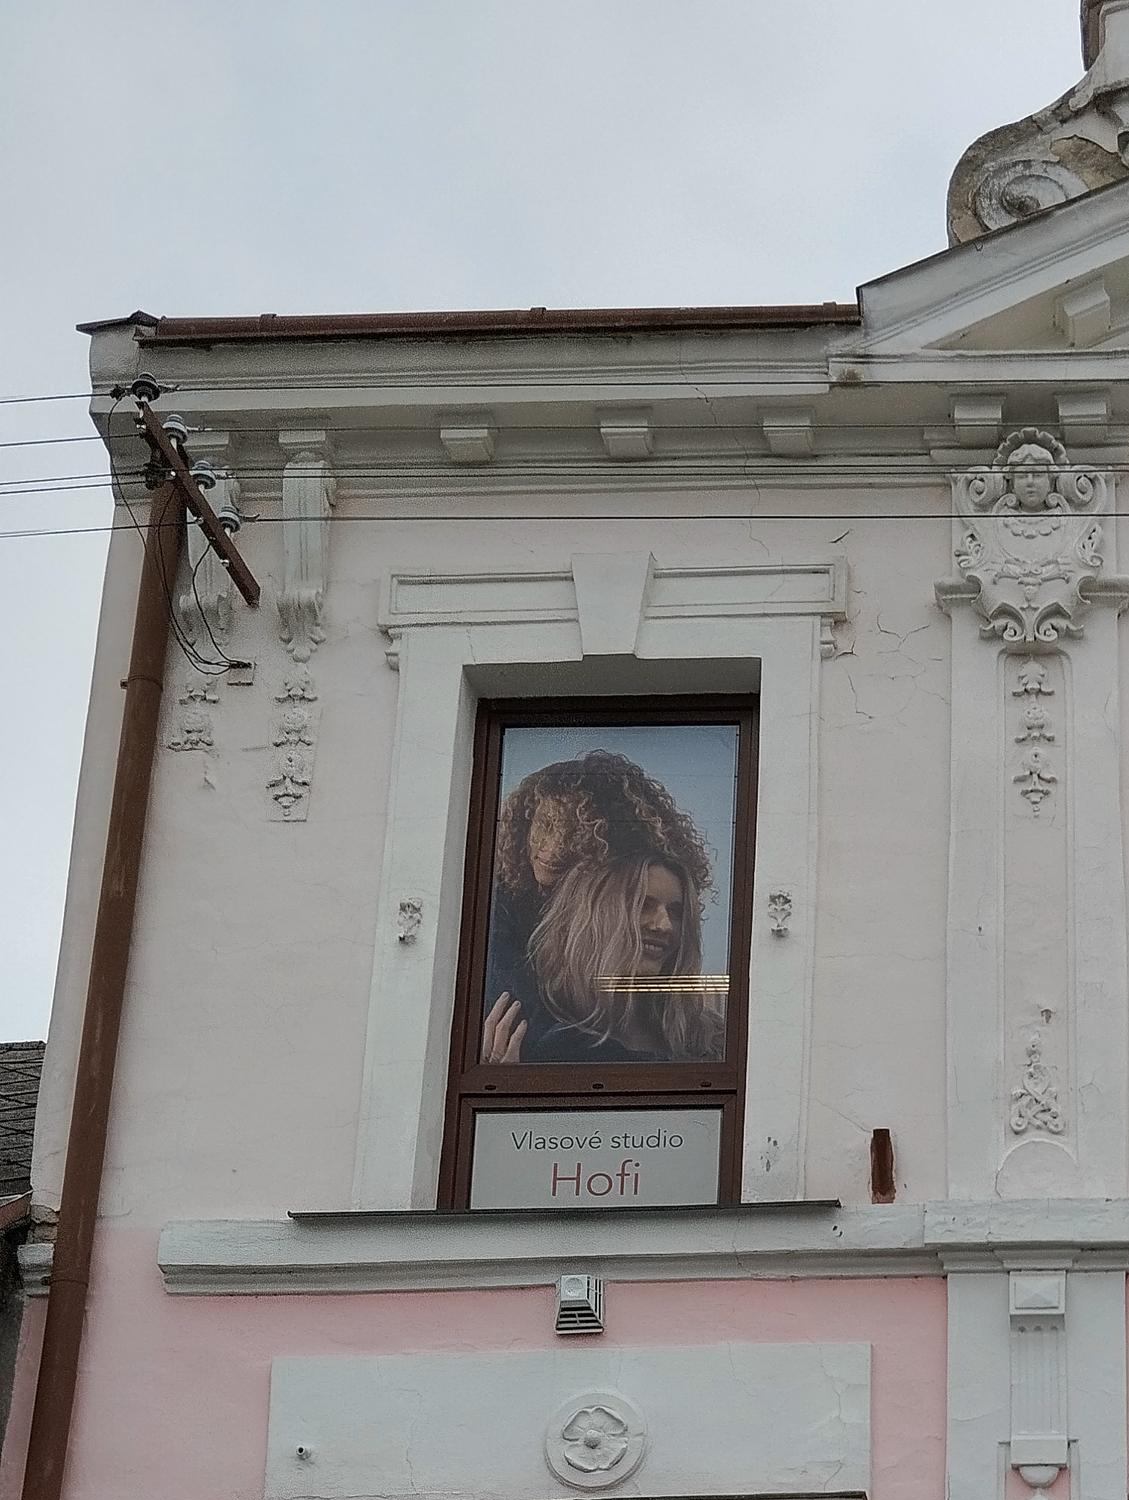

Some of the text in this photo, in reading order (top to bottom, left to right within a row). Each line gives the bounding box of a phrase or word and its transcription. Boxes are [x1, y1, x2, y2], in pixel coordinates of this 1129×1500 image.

[511, 1128, 684, 1150] Vlasové studio
[551, 1159, 641, 1197] Hofi
